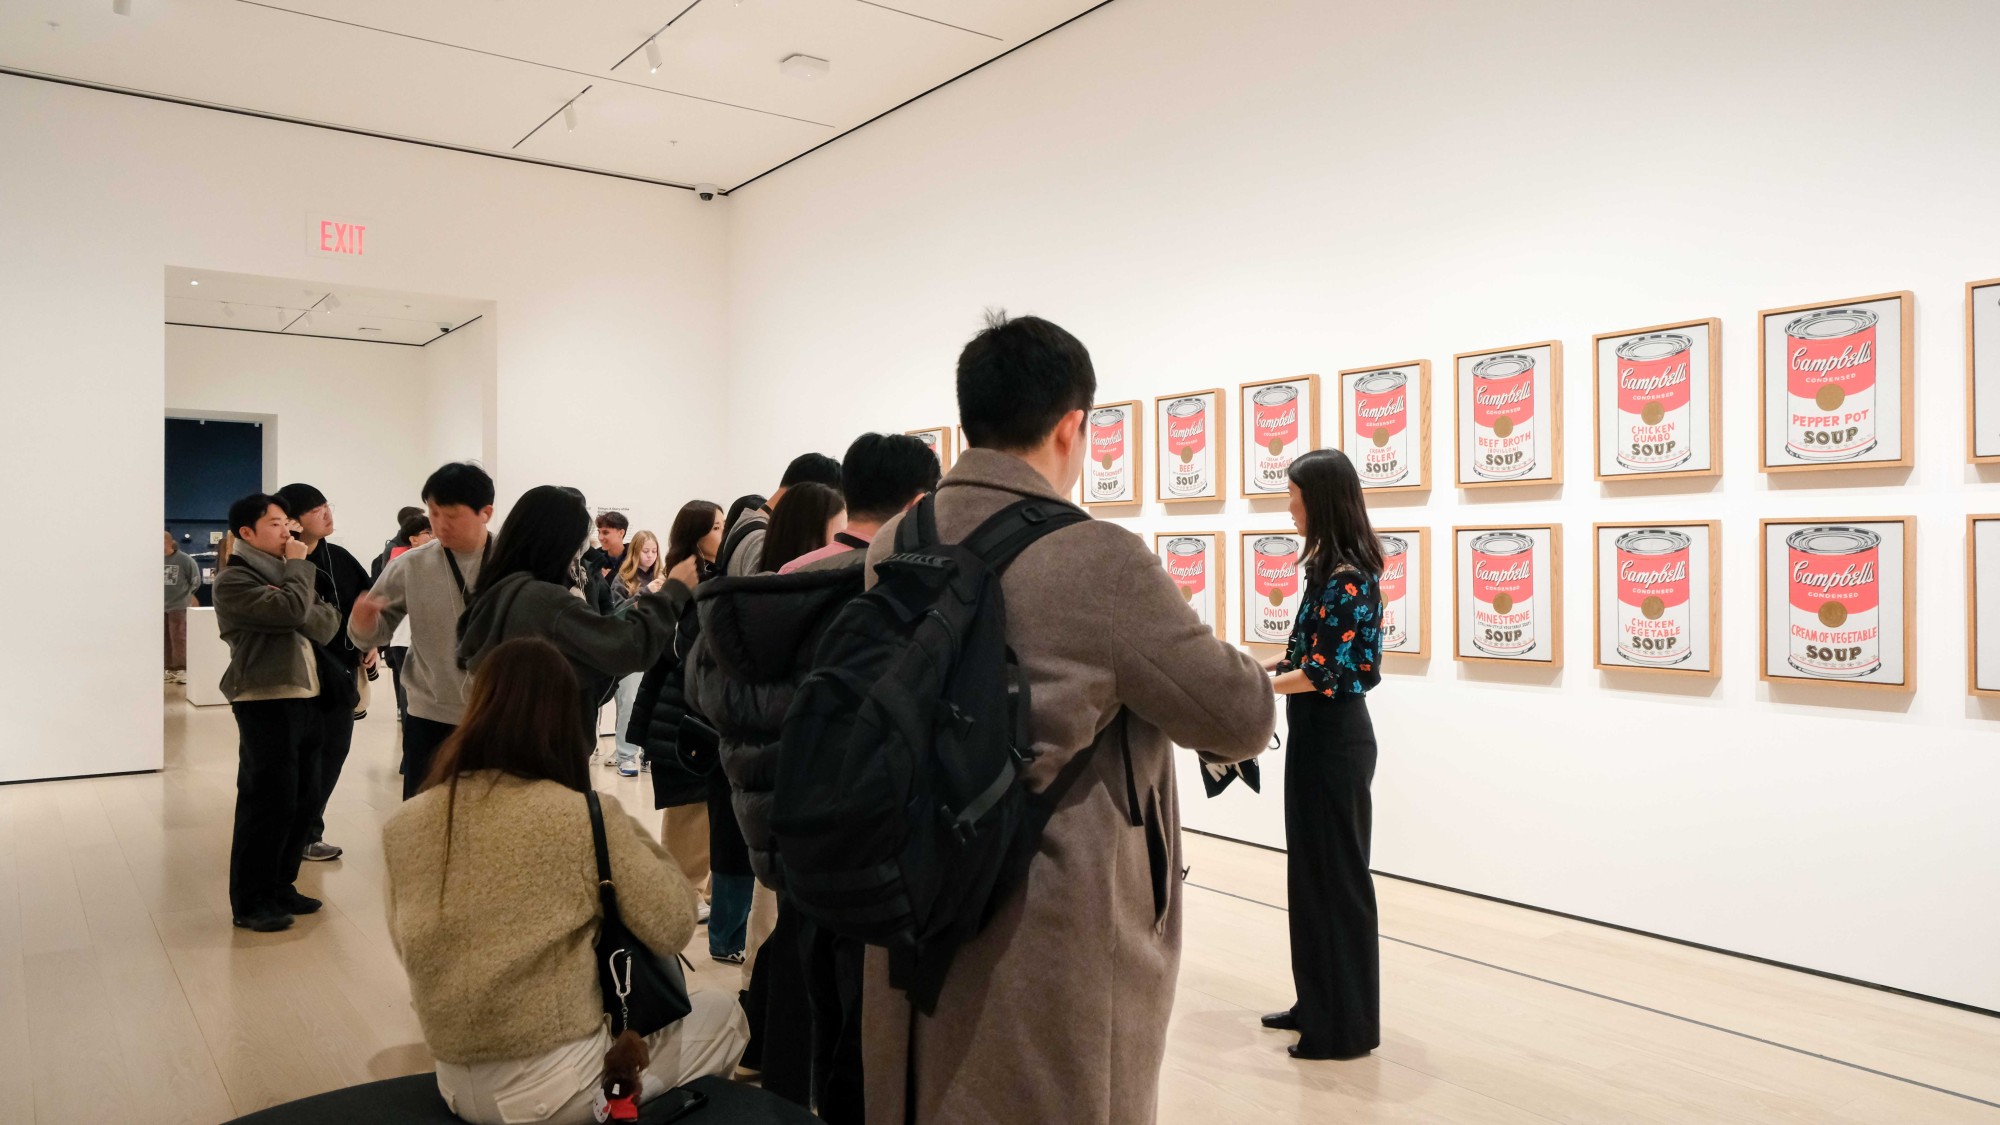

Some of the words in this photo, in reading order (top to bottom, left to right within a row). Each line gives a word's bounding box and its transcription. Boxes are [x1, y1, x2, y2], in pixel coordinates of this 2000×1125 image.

[321, 221, 366, 255] EXIT
[1792, 341, 1872, 377] Campbell's
[1621, 363, 1687, 395] Campbell's
[1806, 373, 1856, 383] CONDENSED
[1476, 381, 1531, 410] Campbell's
[1633, 392, 1674, 400] CONDENSED
[1793, 414, 1840, 427] PEPPER
[1845, 409, 1869, 424] POT
[1631, 422, 1675, 434] CHICKEN
[1479, 437, 1499, 447] BEEF
[1503, 431, 1531, 448] BROTH
[1633, 433, 1670, 442] GUMBO
[1804, 427, 1858, 445] SOUP
[1632, 441, 1675, 456] SOUP
[1367, 451, 1396, 462] CELERY
[1486, 451, 1523, 466] SOUP
[1179, 464, 1194, 472] BEEF
[1366, 460, 1397, 473] SOUP
[1098, 480, 1118, 490] SOUP
[1176, 474, 1199, 485] SOUP
[1476, 560, 1530, 587] Campbell's
[1621, 560, 1685, 589] Campbell's
[1794, 560, 1874, 593] Campbell's
[1264, 607, 1288, 617] ONION
[1476, 610, 1530, 624] MINESTRONE
[1263, 619, 1290, 630] SOUP
[1632, 618, 1674, 628] CHICKEN
[1485, 628, 1522, 642] SOUP
[1625, 624, 1680, 638] VEGETABLE
[1792, 624, 1817, 640] CREAM
[1819, 632, 1829, 643] OF
[1830, 626, 1877, 643] VEGETABLE
[1632, 636, 1677, 650] SOUP
[1806, 645, 1862, 662] SOUP
